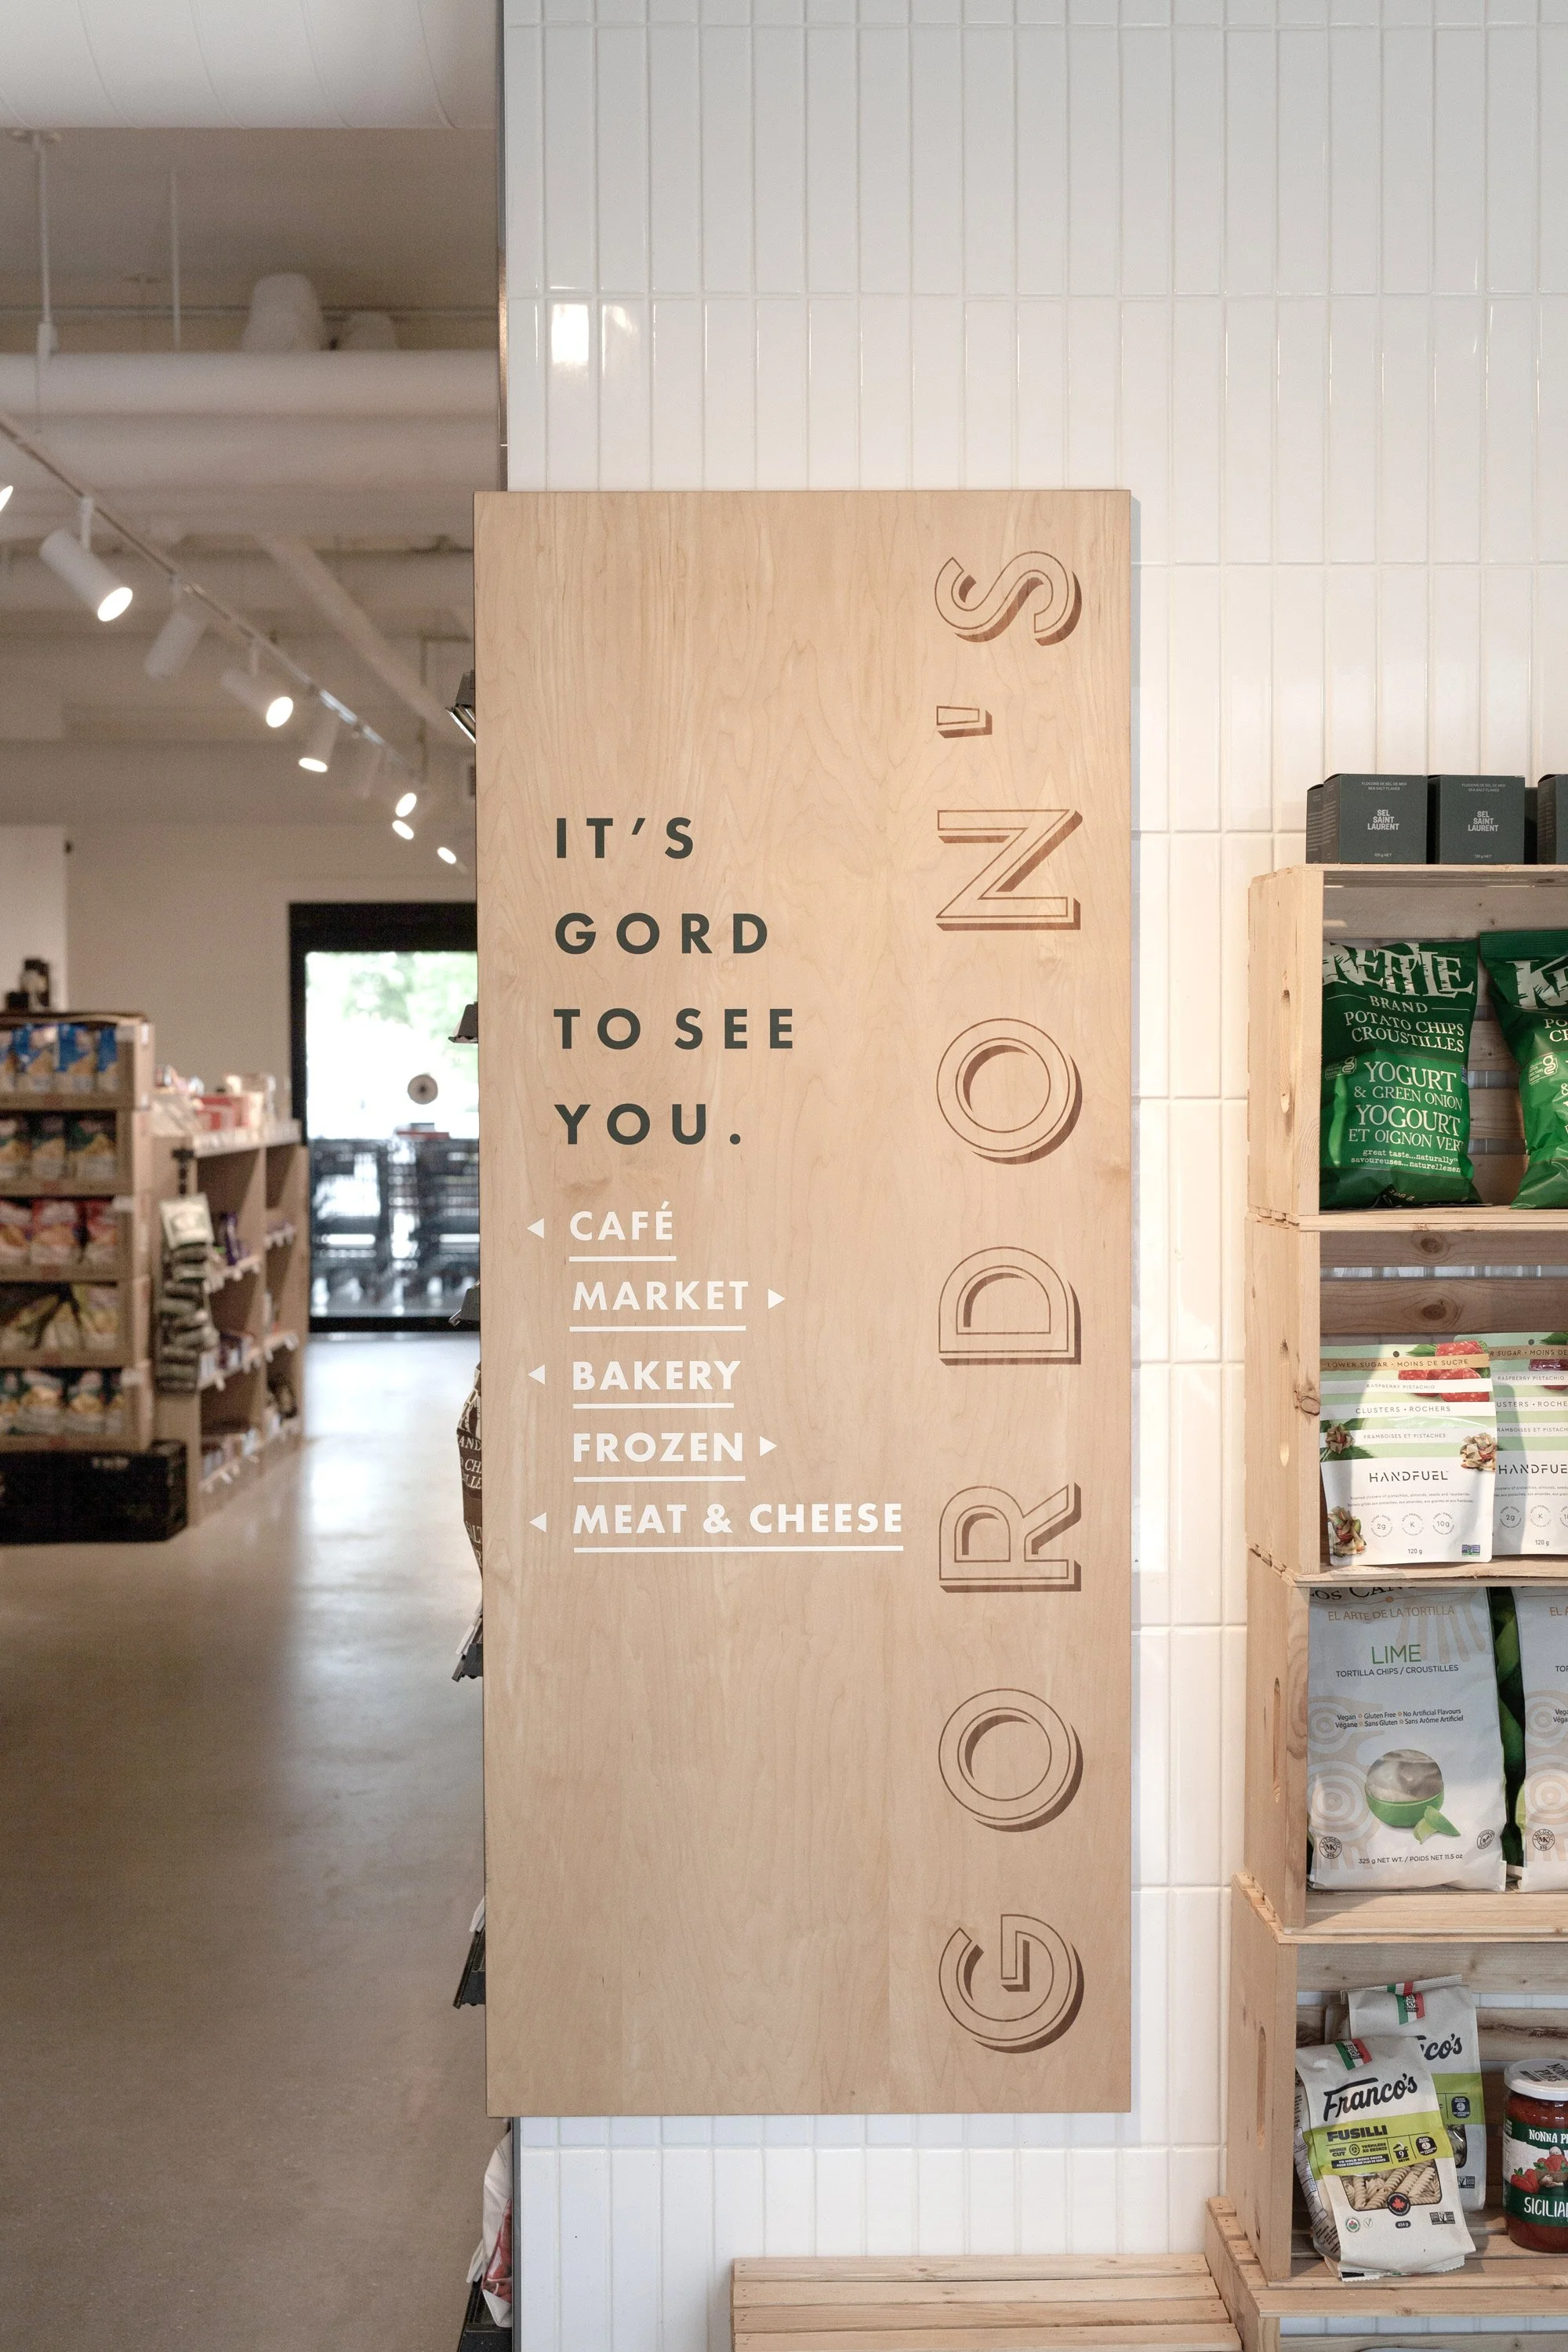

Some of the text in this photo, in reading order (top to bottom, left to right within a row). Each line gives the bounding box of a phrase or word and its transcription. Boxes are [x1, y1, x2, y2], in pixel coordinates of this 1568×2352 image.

[556, 817, 694, 859] IT'S
[555, 913, 768, 954] GORD
[1369, 995, 1428, 1013] BRAND
[554, 1007, 793, 1051] TO SEE
[1344, 1011, 1465, 1036] POTATO CHIPS
[1352, 1026, 1465, 1052] CROUSTILLES
[1364, 1061, 1457, 1092] YOGURT
[1354, 1086, 1463, 1111] & GREEN ONION
[554, 1104, 741, 1145] YOU.
[1356, 1104, 1461, 1137] YOGOURT
[1348, 1128, 1465, 1153] ET OIGNON VERT
[1410, 1162, 1461, 1173] naturellemen
[570, 1201, 673, 1241] CAFÉ
[572, 1281, 749, 1311] MARKET
[935, 550, 1083, 2054] GORDON'S
[572, 1360, 742, 1390] BAKERY
[573, 1432, 743, 1462] FROZEN
[1370, 1471, 1448, 1483] HANDFUEL
[573, 1503, 902, 1534] MEAT & CHEESE
[1328, 1605, 1455, 1621] EL ARTE DE LA TORTILLA
[1372, 1644, 1421, 1664] LIME
[1336, 1669, 1374, 1678] TORTILLA
[1376, 1667, 1398, 1675] CHIPS
[1406, 1664, 1459, 1674] CROUSTILLES
[1323, 2073, 1418, 2122] Franco's
[1327, 2125, 1388, 2142] FUSILLI
[1529, 2129, 1558, 2143] NONNA
